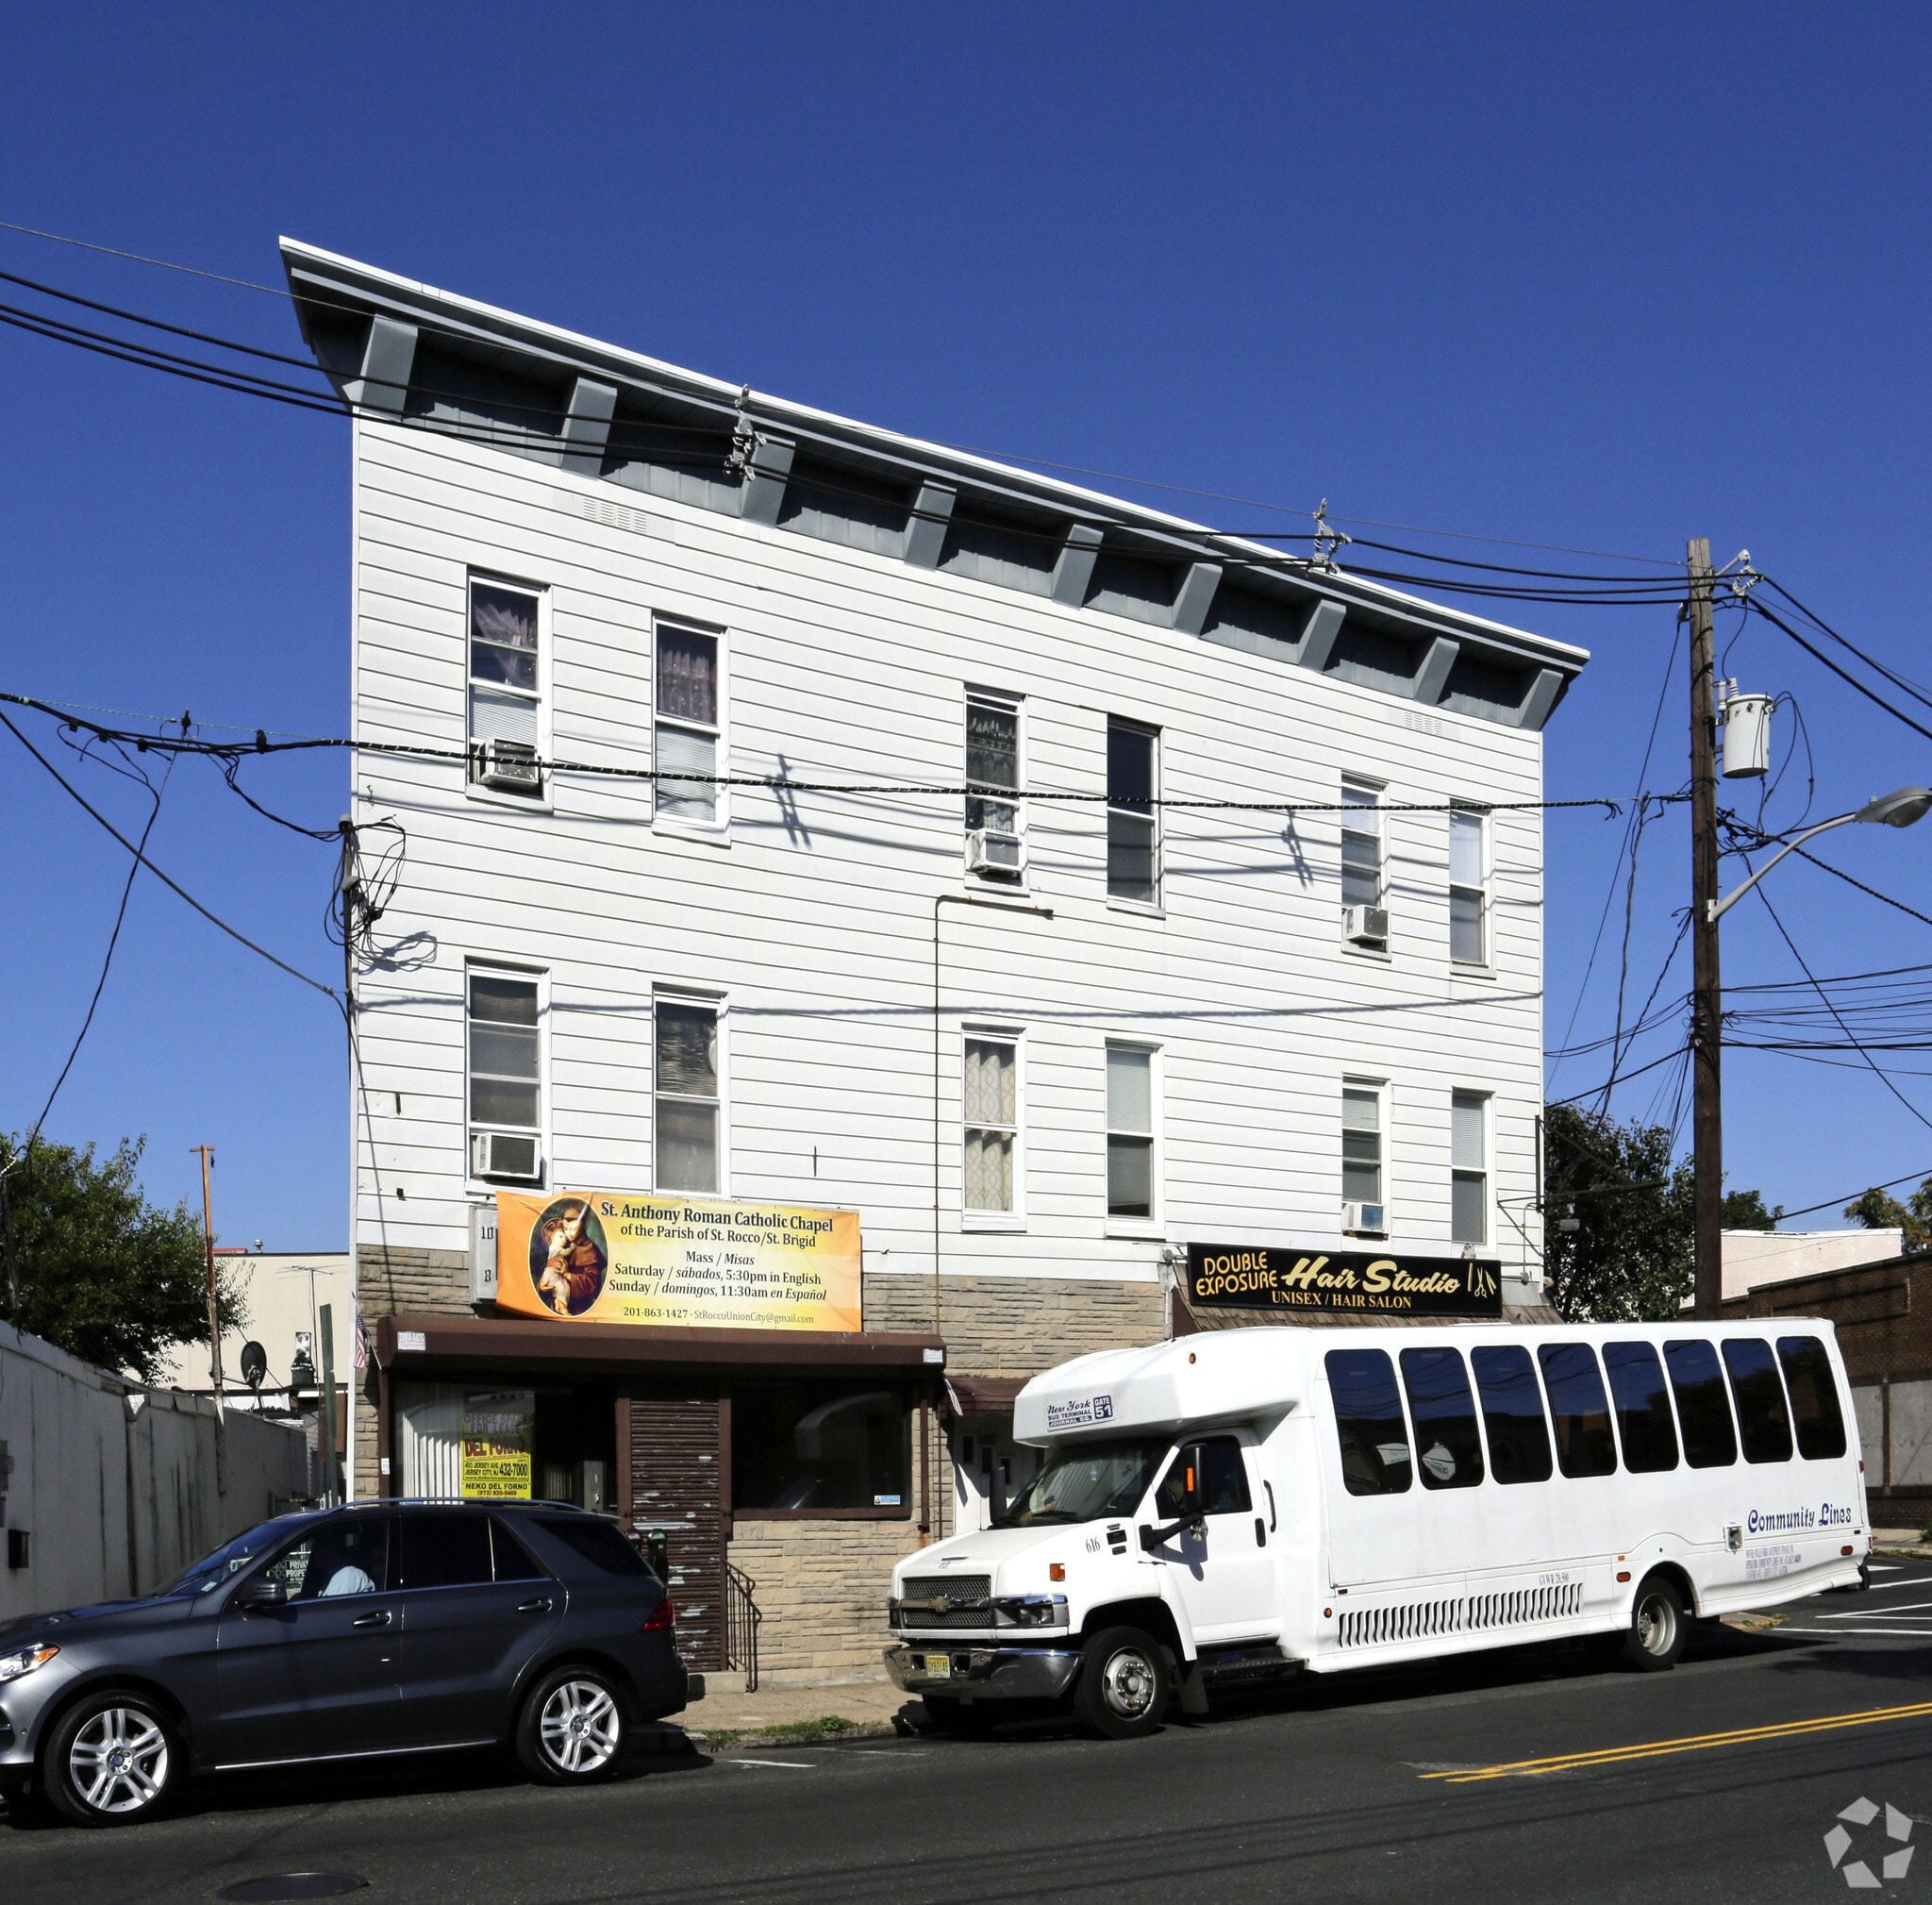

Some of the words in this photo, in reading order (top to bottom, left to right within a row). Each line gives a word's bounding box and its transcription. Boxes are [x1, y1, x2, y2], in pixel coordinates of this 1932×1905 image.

[601, 1201, 617, 1216] St.
[621, 1203, 680, 1225] Anthony
[684, 1208, 731, 1225] Roman
[735, 1212, 787, 1228] Catholic
[791, 1215, 833, 1234] Chapel
[621, 1223, 633, 1235] of
[635, 1224, 654, 1236] the
[657, 1226, 694, 1239] Parish
[697, 1228, 709, 1240] of
[710, 1228, 724, 1241] St.
[727, 1229, 779, 1246] Rocco/St.
[783, 1233, 815, 1249] Brigid
[686, 1250, 713, 1262] Mass
[724, 1253, 755, 1265] Misas
[484, 1269, 491, 1281] 8
[614, 1262, 665, 1279] Saturday
[675, 1266, 723, 1281] sábados,
[725, 1269, 767, 1284] 5:30pm
[770, 1271, 780, 1282] in
[782, 1272, 822, 1286] English
[1204, 1251, 1268, 1276] DOUBLE
[1281, 1256, 1360, 1290] Hair
[1362, 1260, 1460, 1294] Studio
[608, 1278, 651, 1295] Sunday
[661, 1282, 718, 1297] domingos,
[721, 1285, 768, 1297] 11:30am
[770, 1290, 783, 1298] en
[785, 1288, 826, 1302] Español
[1196, 1270, 1277, 1295] EXPOSURE
[1271, 1291, 1322, 1305] UNISEX
[1332, 1294, 1366, 1307] HAIR
[1369, 1295, 1411, 1309] SALON
[624, 1306, 688, 1318] 201-863-1427
[693, 1310, 814, 1324] StRoccoUnionCity@gmail.com
[1047, 1405, 1065, 1414] New
[1067, 1398, 1091, 1412] York
[1061, 1409, 1091, 1418] TERMINAL
[1095, 1405, 1112, 1419] 51
[465, 1438, 488, 1457] DEL
[499, 1462, 527, 1476] 432-7000
[1747, 1506, 1815, 1533] Community
[1818, 1502, 1852, 1526] Lines
[1086, 1536, 1101, 1553] 616
